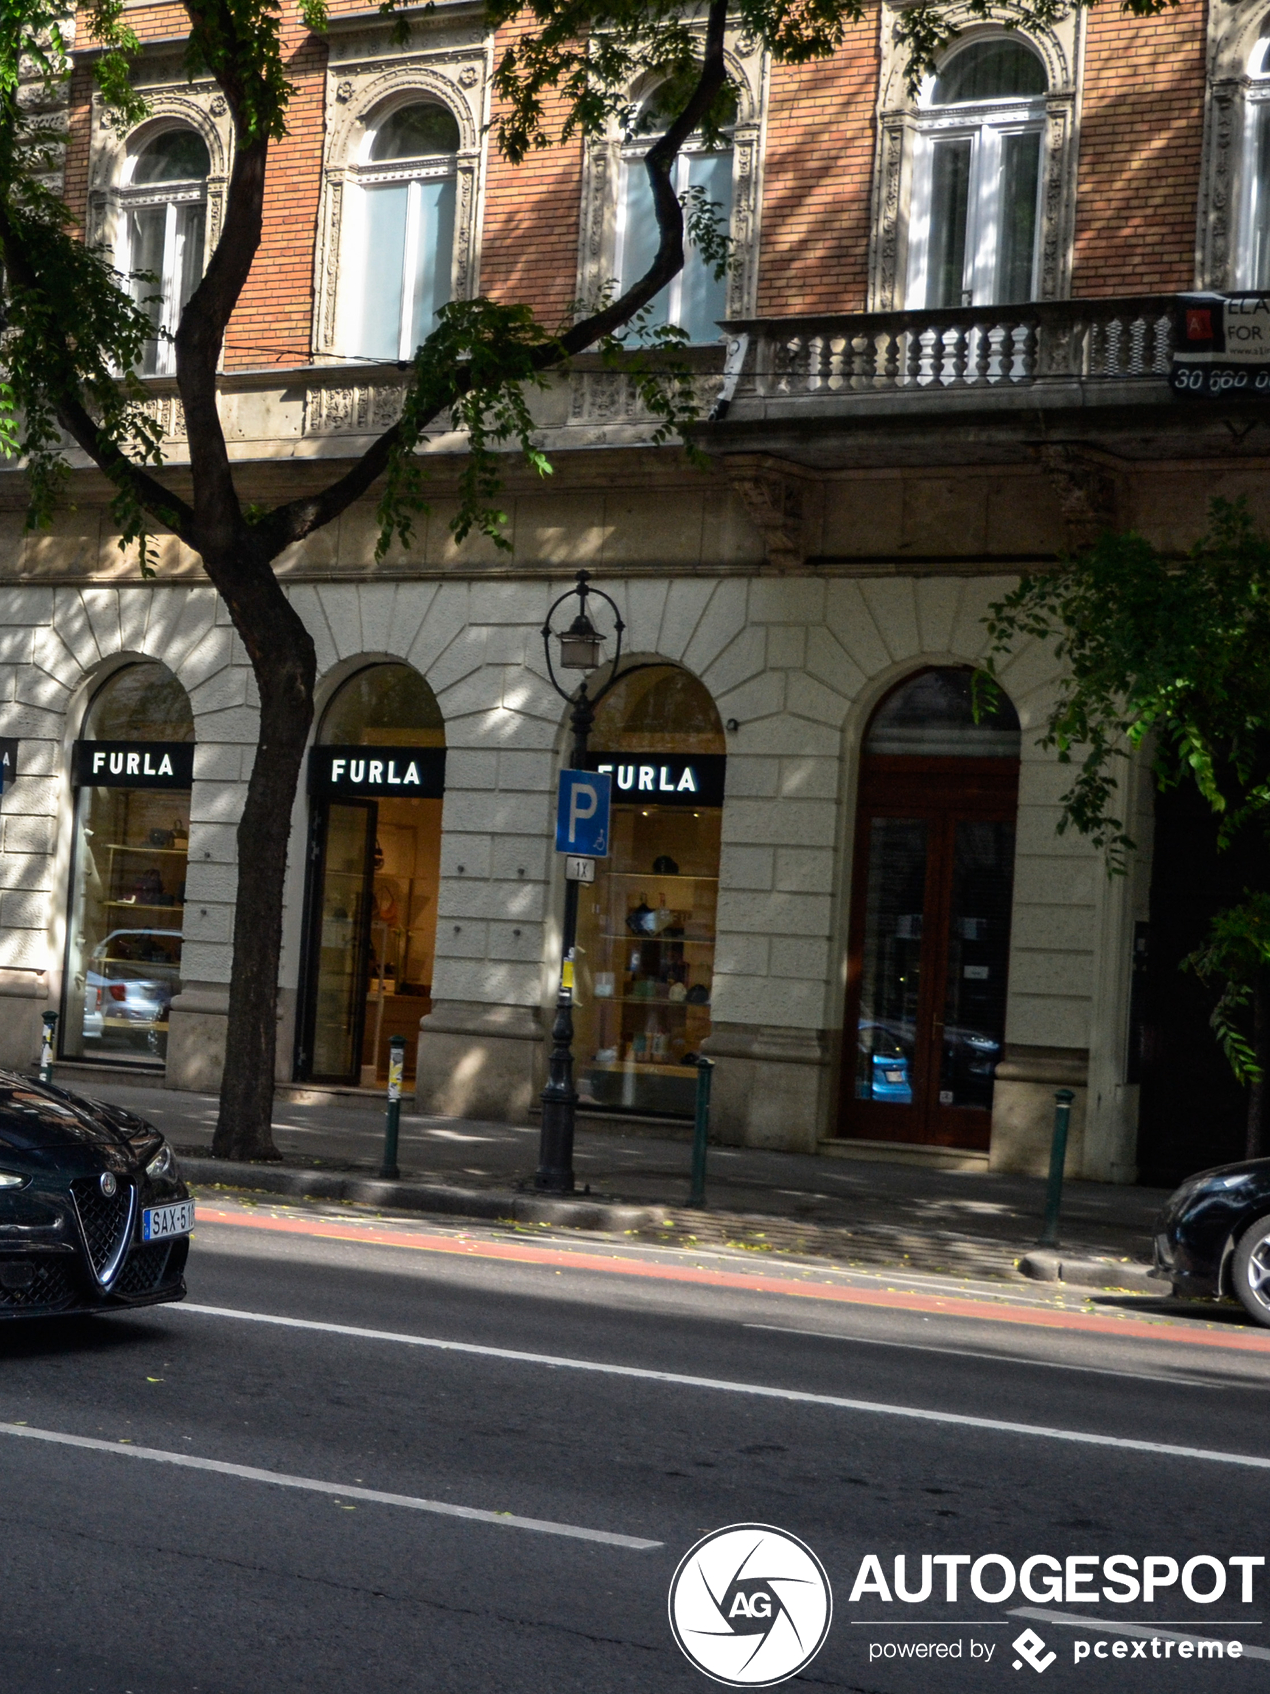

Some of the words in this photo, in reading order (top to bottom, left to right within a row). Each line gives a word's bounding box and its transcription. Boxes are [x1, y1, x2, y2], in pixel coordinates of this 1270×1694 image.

[1228, 326, 1263, 340] FOR
[1175, 369, 1203, 389] 30
[1255, 371, 1270, 388] 0
[93, 753, 173, 775] FURLA
[332, 760, 420, 784] FURLA
[568, 783, 598, 843] P
[575, 861, 587, 878] 1X
